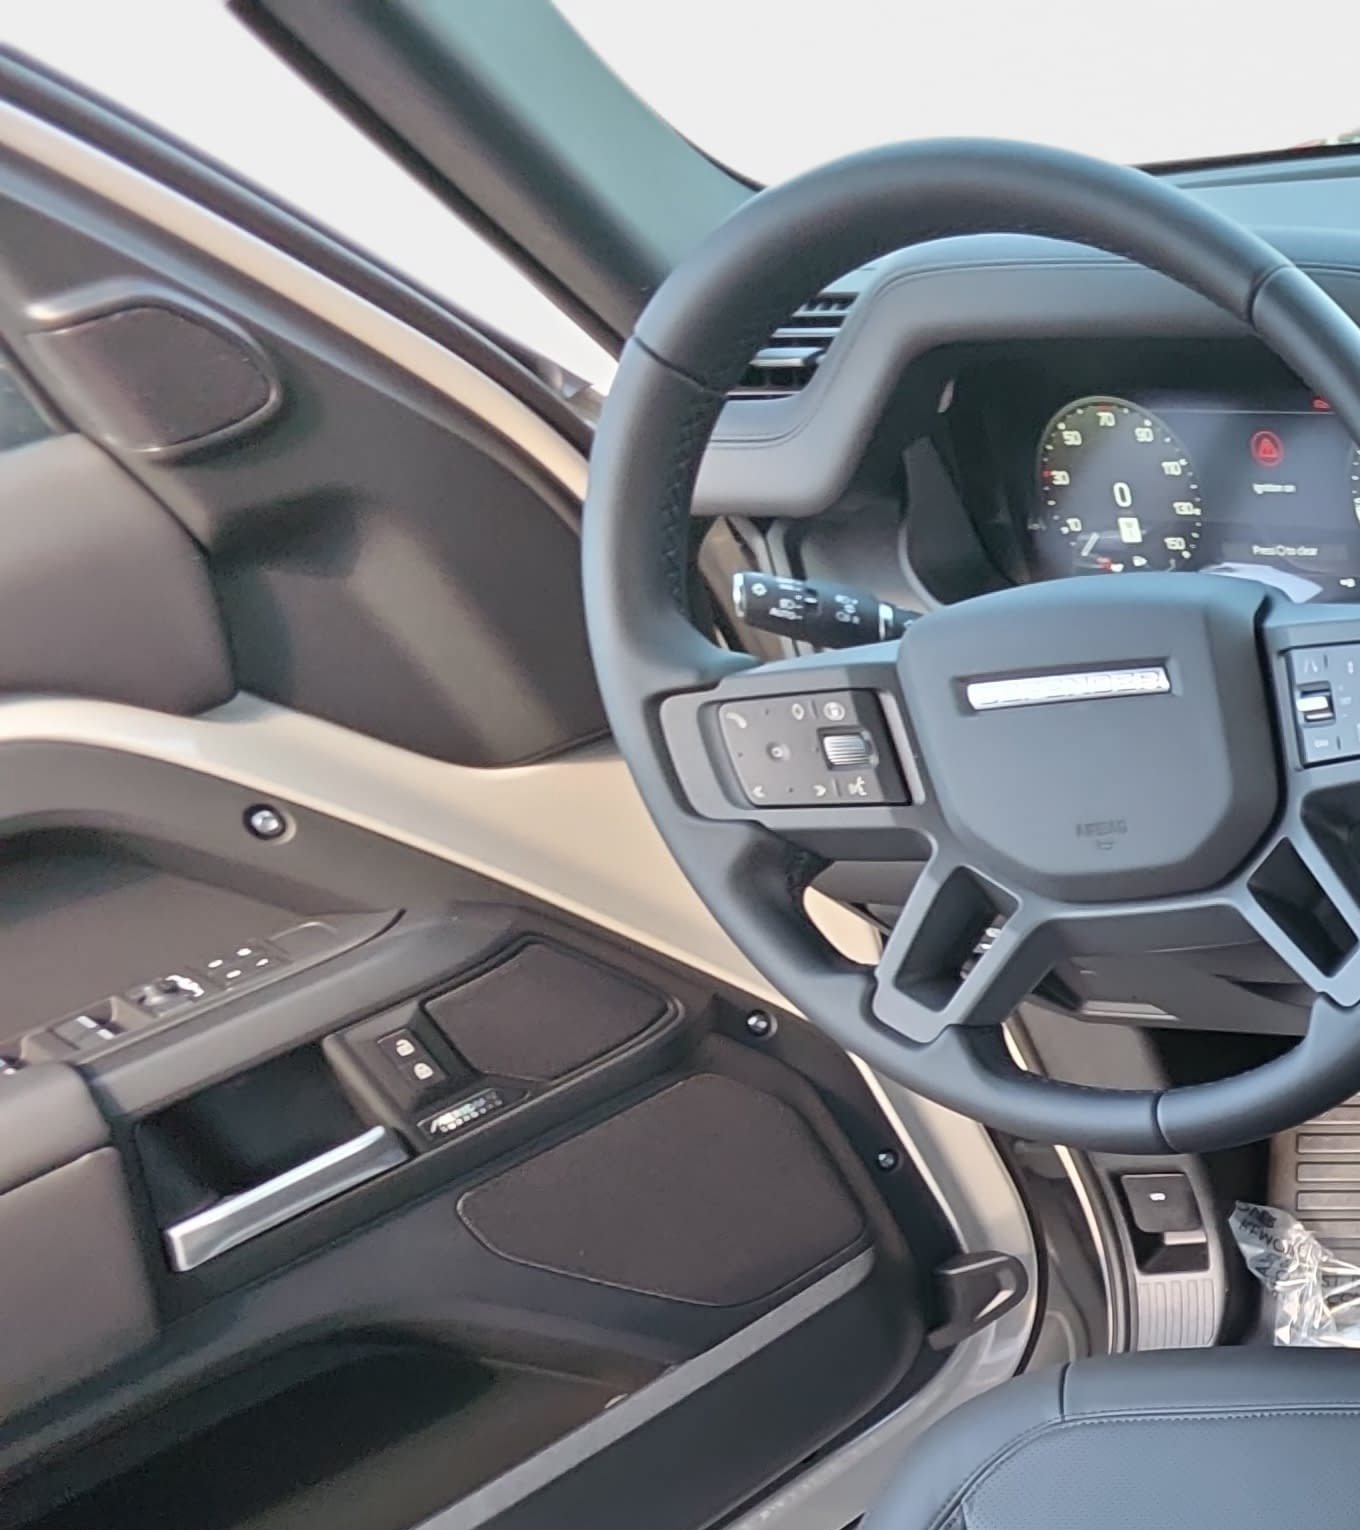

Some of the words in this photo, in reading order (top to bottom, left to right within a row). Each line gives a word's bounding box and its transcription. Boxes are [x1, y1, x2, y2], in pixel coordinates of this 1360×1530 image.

[1096, 411, 1115, 427] 70
[1062, 430, 1082, 446] 50
[1051, 470, 1070, 485] 30
[1113, 482, 1132, 507] 0
